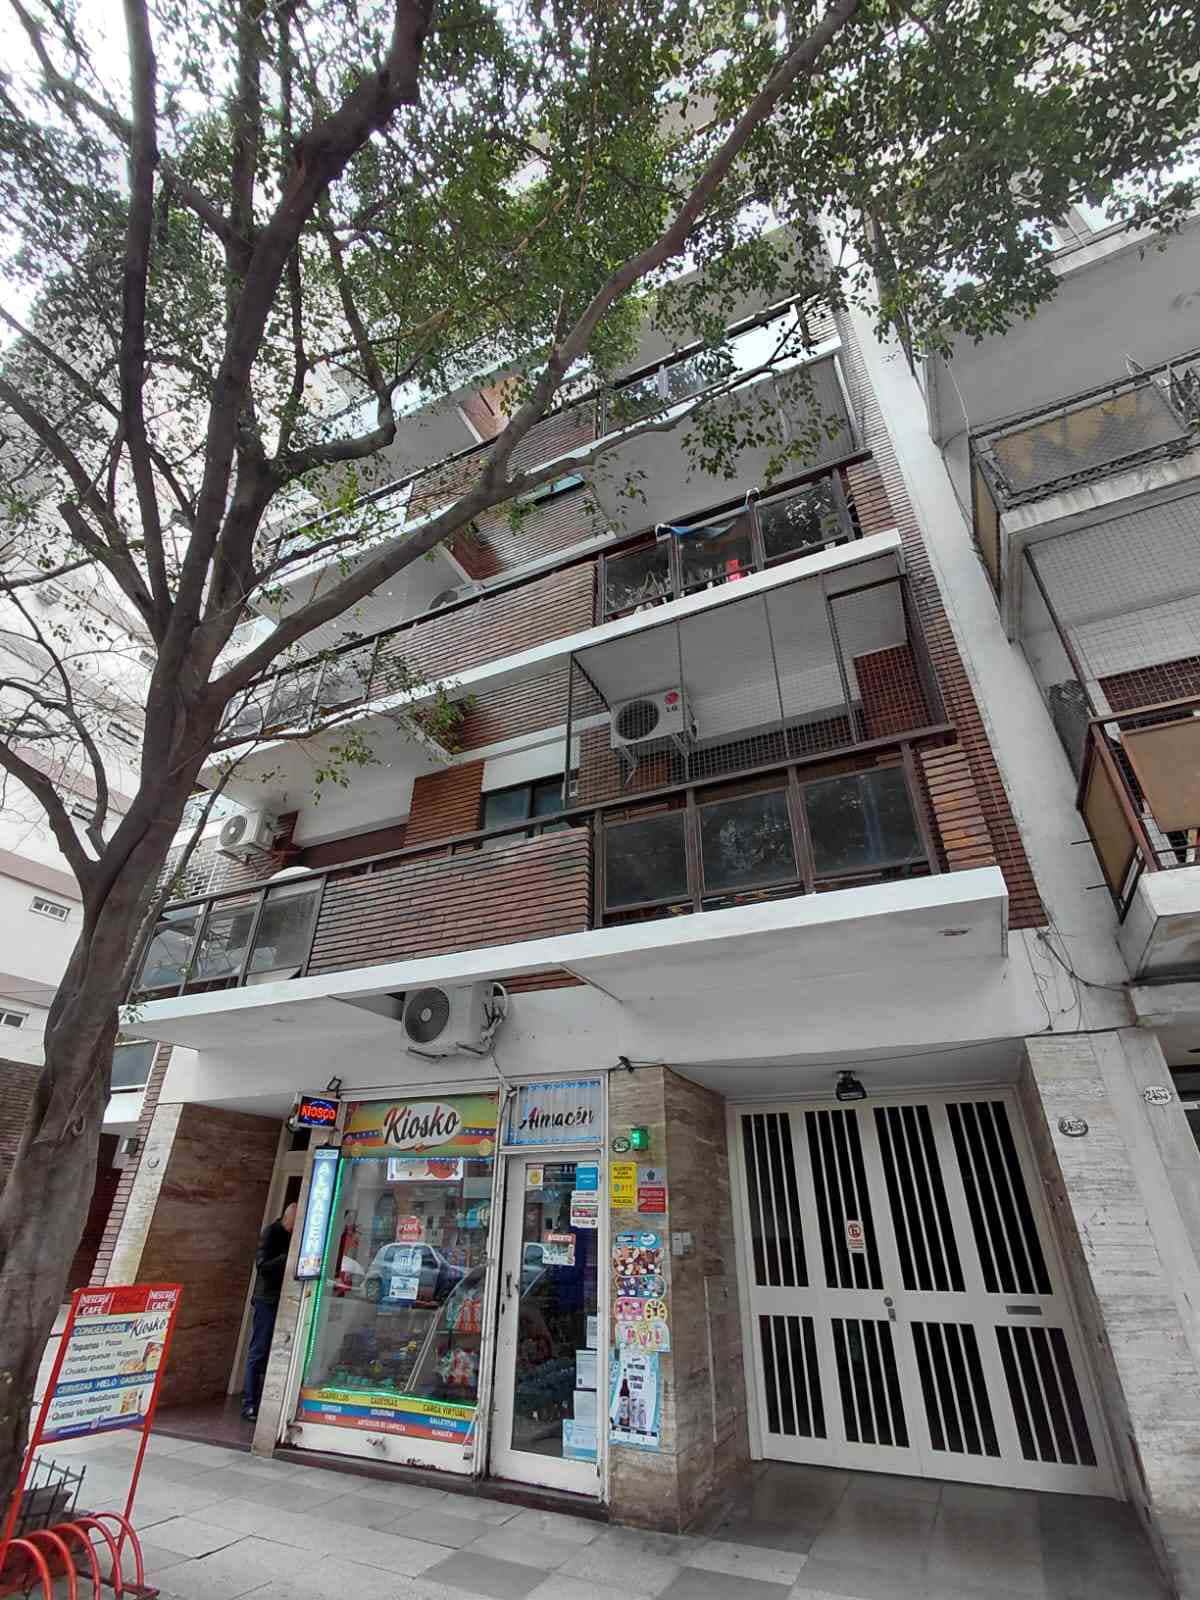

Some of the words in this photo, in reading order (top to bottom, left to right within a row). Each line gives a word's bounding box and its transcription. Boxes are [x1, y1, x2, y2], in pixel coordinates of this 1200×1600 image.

[301, 1105, 336, 1120] KIOSCO
[519, 1106, 595, 1130] Almacén
[383, 1104, 460, 1144] Kiosko
[129, 1318, 168, 1339] Kiosko
[95, 1378, 117, 1389] HIELO
[422, 1403, 441, 1414] CARGA
[441, 1406, 466, 1419] VIRTUAL
